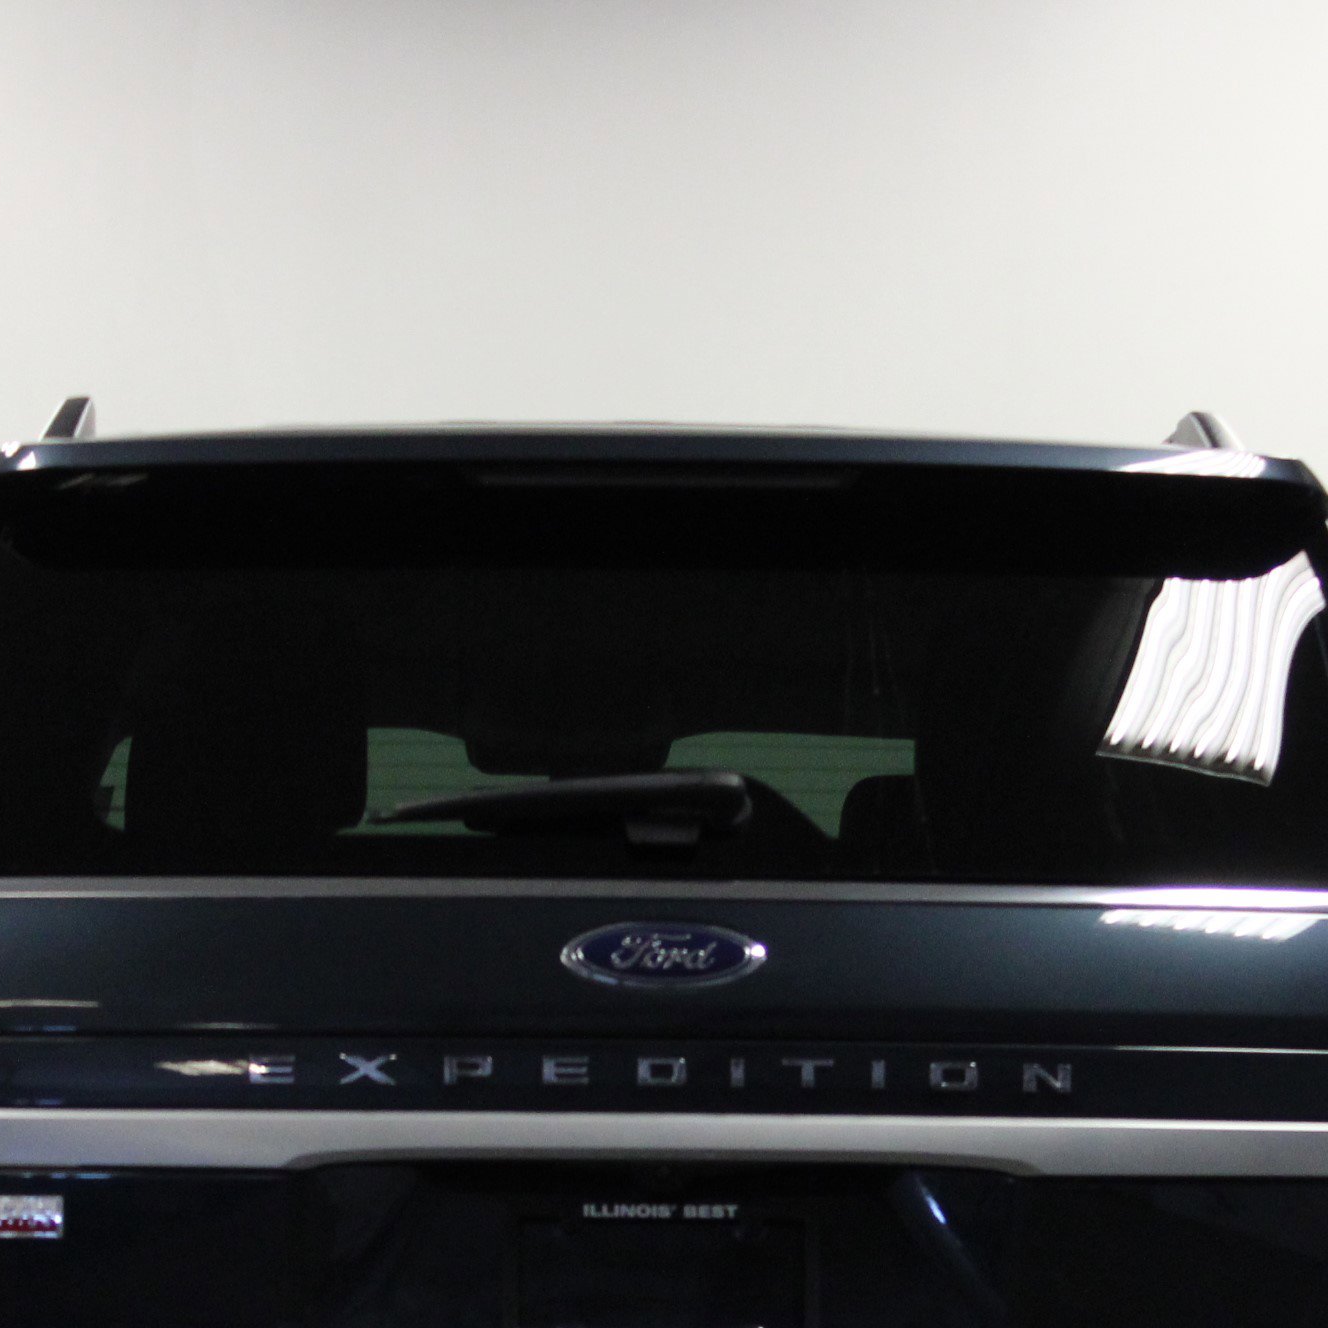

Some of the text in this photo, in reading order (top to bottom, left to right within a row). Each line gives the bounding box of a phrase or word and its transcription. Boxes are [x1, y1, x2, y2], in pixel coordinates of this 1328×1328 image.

[610, 932, 717, 970] Ford
[248, 1053, 1074, 1094] EXPEDITION
[582, 1203, 739, 1219] ILLINOIS' BEST
